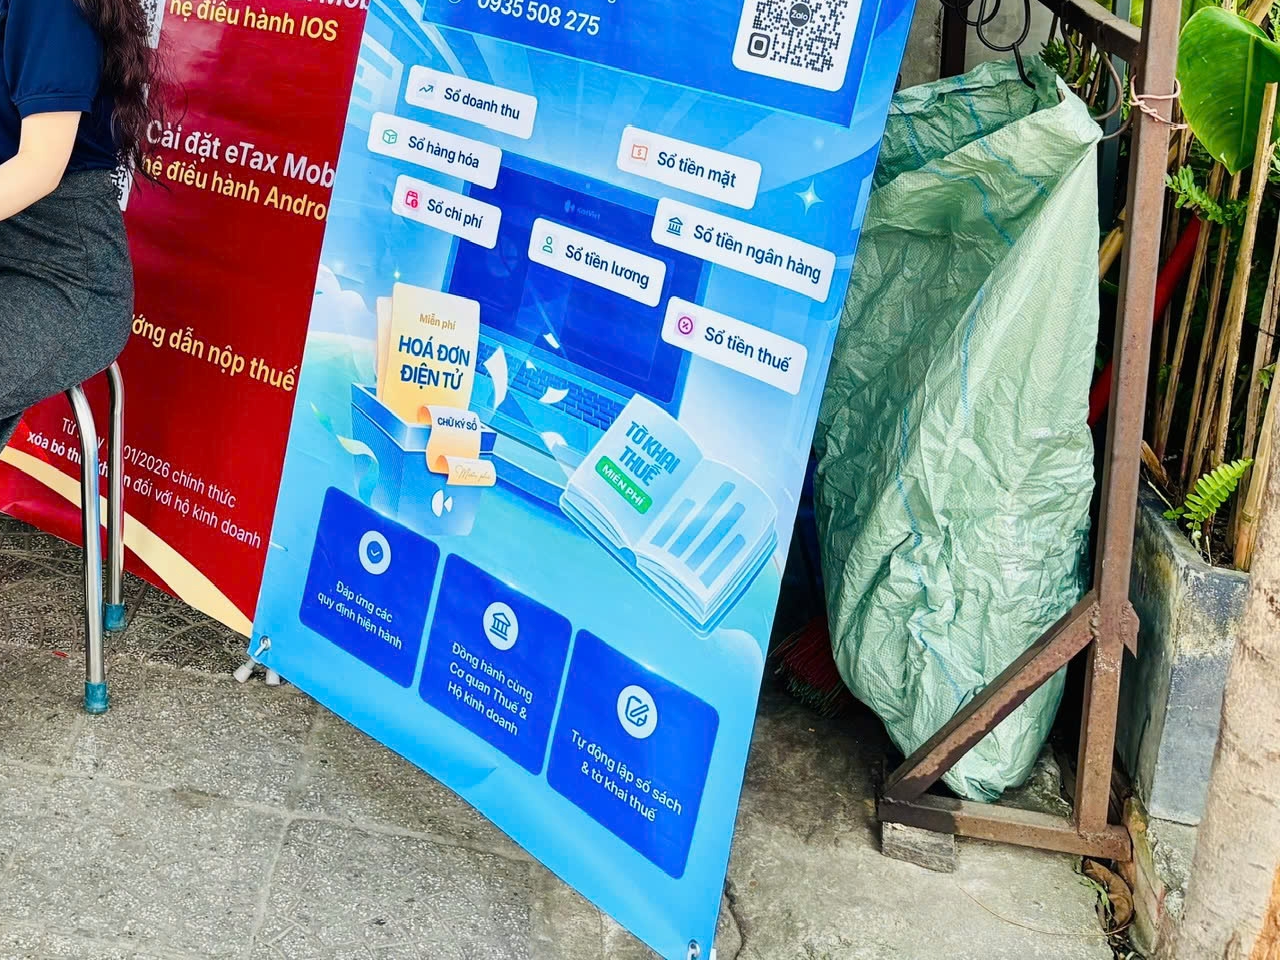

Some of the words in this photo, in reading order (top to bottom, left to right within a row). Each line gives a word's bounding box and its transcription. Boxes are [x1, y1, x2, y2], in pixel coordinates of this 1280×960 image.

[243, 3, 295, 33] hành
[300, 14, 339, 42] IOS
[526, 1, 562, 27] 508
[563, 10, 601, 36] 275
[444, 87, 462, 103] Sổ
[462, 92, 498, 114] doanh
[501, 102, 520, 120] thu
[408, 136, 425, 151] Sổ
[426, 140, 456, 164] hàng
[458, 150, 480, 169] hóa
[657, 152, 678, 169] Sổ
[679, 158, 706, 178] tiền
[708, 165, 737, 189] mặt
[419, 311, 441, 327] Miễn
[441, 319, 456, 332] phí
[169, 325, 205, 360] dẫn
[208, 344, 245, 376] nộp
[249, 356, 298, 392] thuế
[398, 334, 434, 359] HOÁ
[437, 343, 470, 367] ĐƠN
[400, 364, 439, 390] ĐIỆN
[443, 367, 464, 390] TỬ
[455, 418, 465, 428] KÝ
[619, 446, 662, 486] THUẾ
[626, 421, 649, 444] TỜ
[641, 436, 680, 475] KHAI
[27, 430, 49, 451] xóa
[50, 439, 65, 456] bỏ
[133, 478, 153, 497] đối
[154, 489, 173, 509] với
[174, 495, 190, 518] hộ
[192, 500, 218, 529] kinh
[221, 518, 262, 549] doanh
[172, 469, 205, 496] chính
[208, 481, 237, 509] thức
[625, 487, 646, 506] PHÍ
[336, 580, 355, 602] Đáp
[355, 591, 375, 615] ứng
[375, 604, 393, 622] các
[317, 592, 335, 610] quy
[336, 600, 356, 621] định
[356, 612, 377, 634] hiện
[378, 622, 403, 650] hành
[571, 729, 587, 750] Tự
[587, 744, 616, 773] động
[616, 761, 634, 783] lập
[635, 776, 652, 793] sổ
[652, 787, 683, 816] sách
[581, 761, 589, 775] &
[591, 769, 603, 783] tờ
[604, 776, 628, 803] khai
[629, 794, 658, 822] thuế
